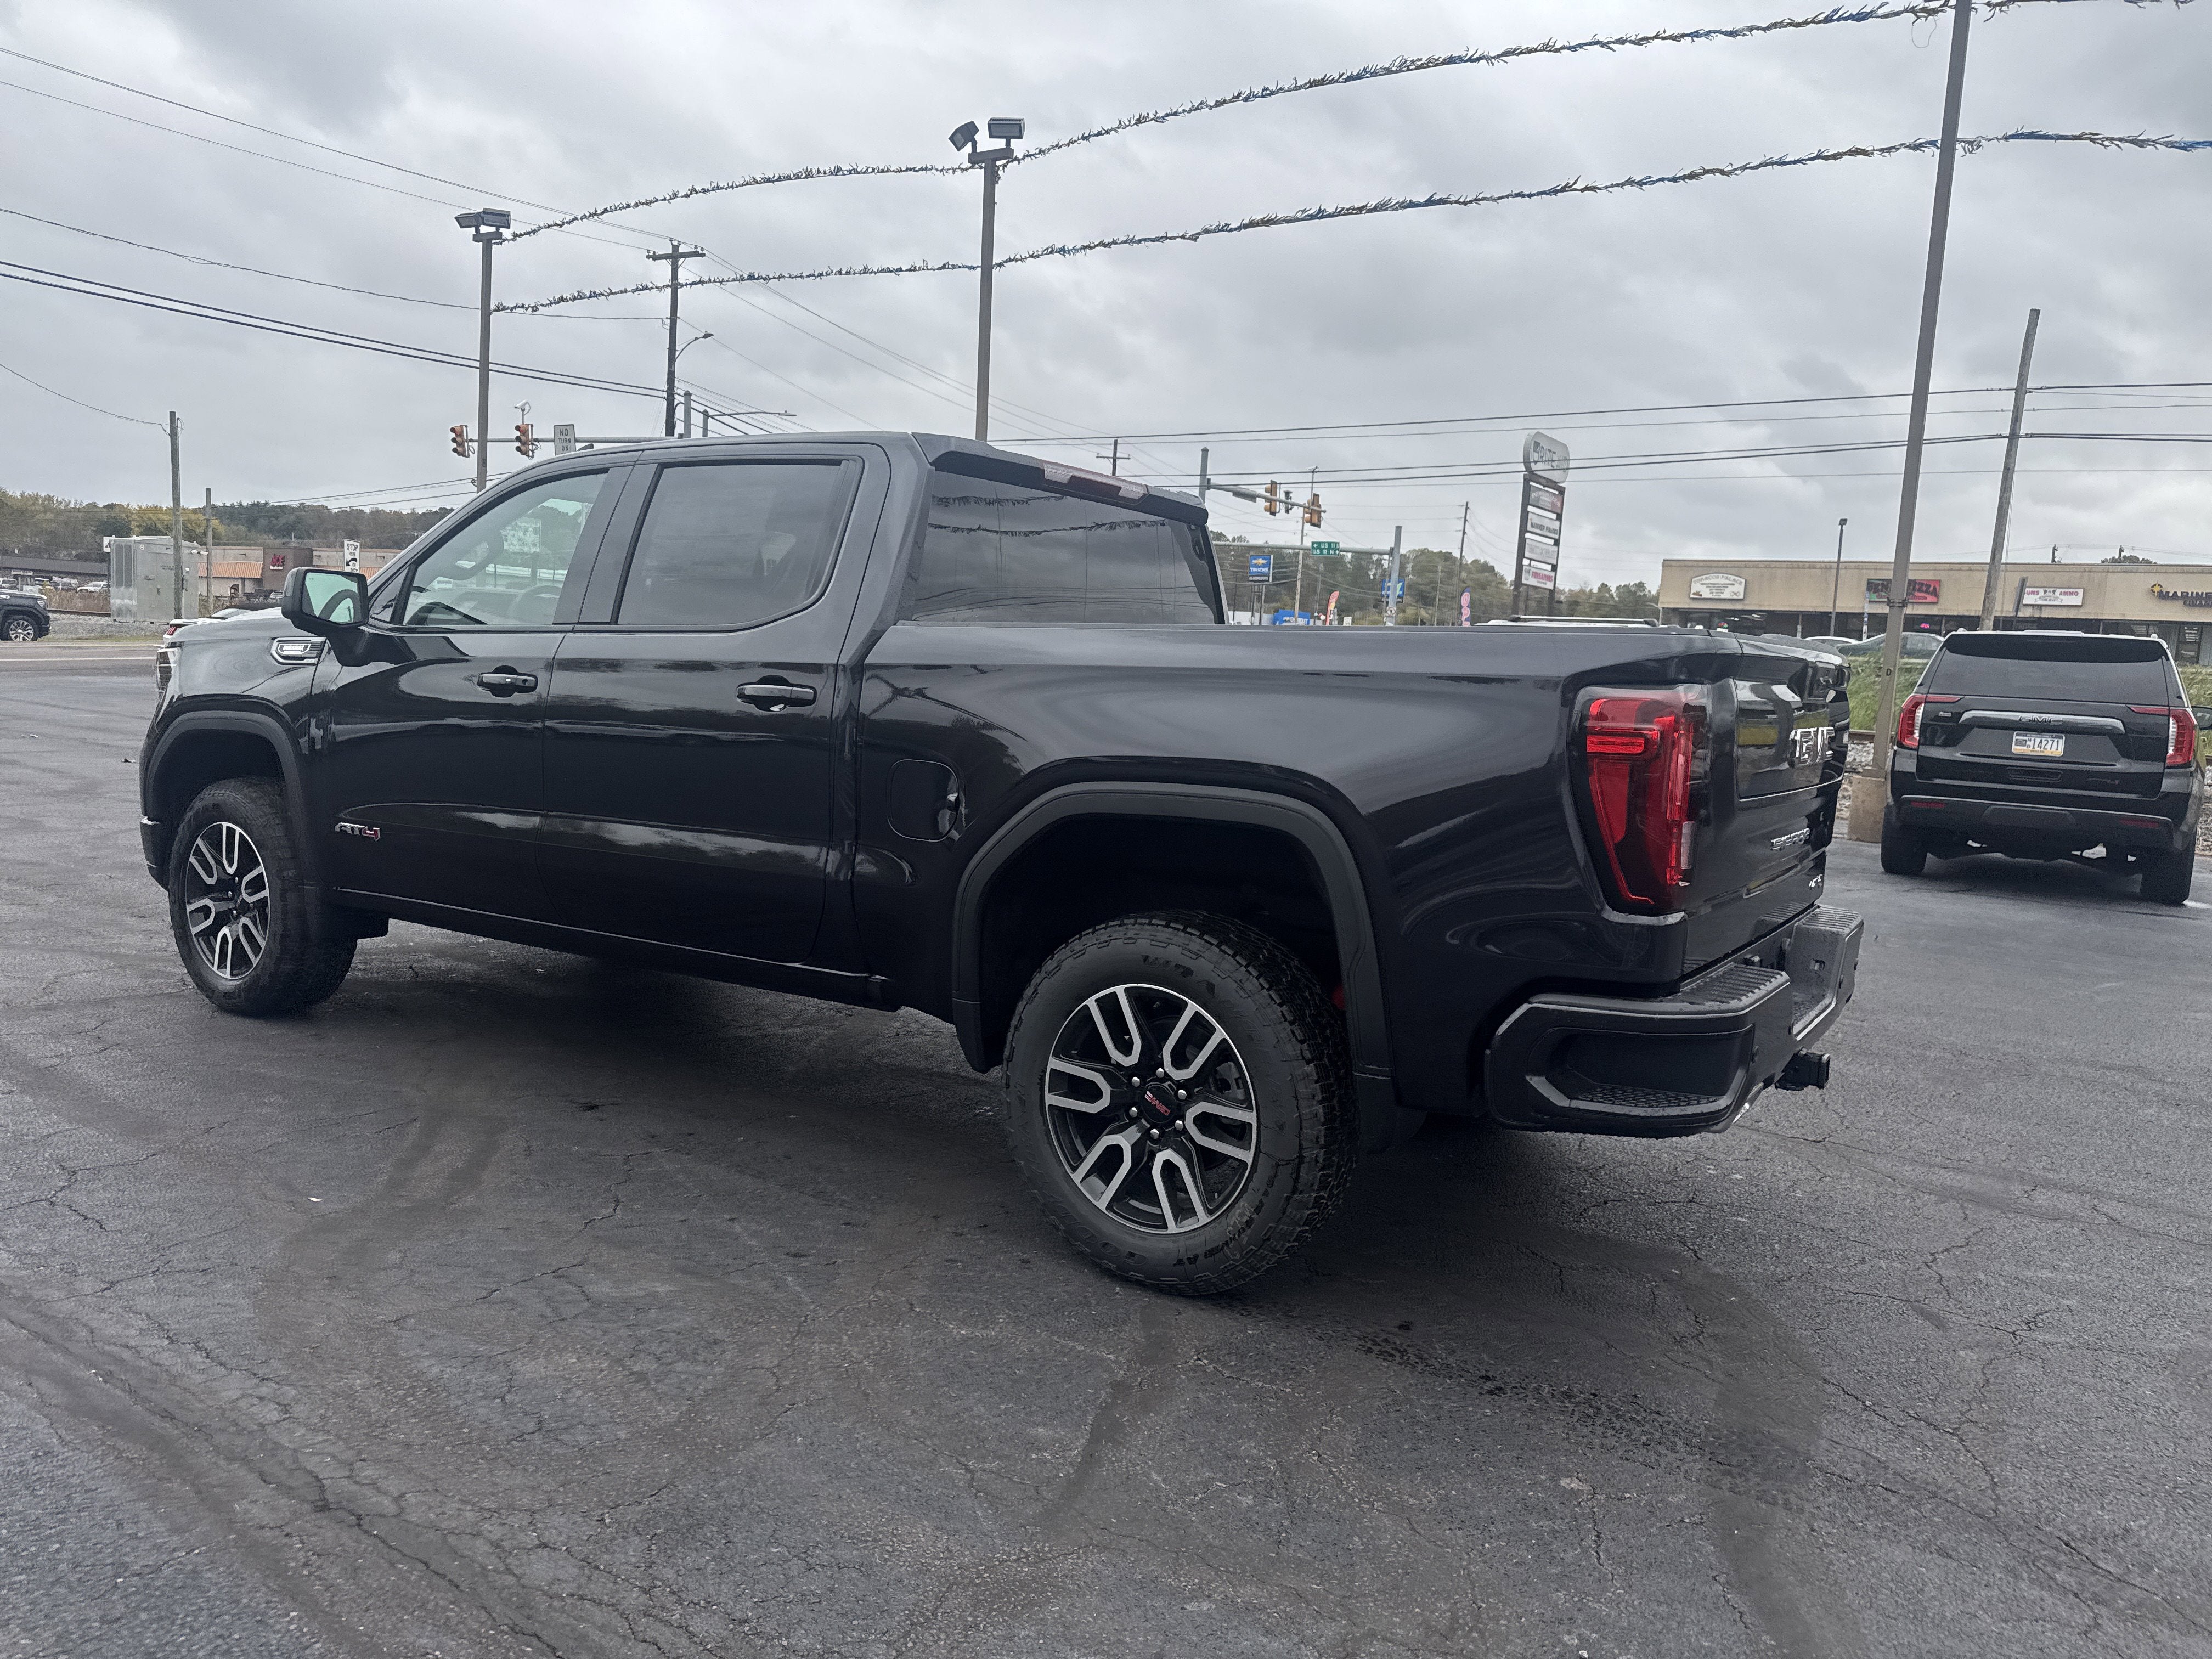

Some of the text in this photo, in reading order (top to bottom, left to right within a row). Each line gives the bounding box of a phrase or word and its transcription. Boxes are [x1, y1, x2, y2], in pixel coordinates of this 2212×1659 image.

[346, 543, 358, 551] STOP
[270, 554, 284, 566] ACE
[1886, 668, 1892, 676] D
[2032, 738, 2059, 751] 14271
[335, 822, 381, 842] AT4
[1144, 1090, 1170, 1116] GMC
